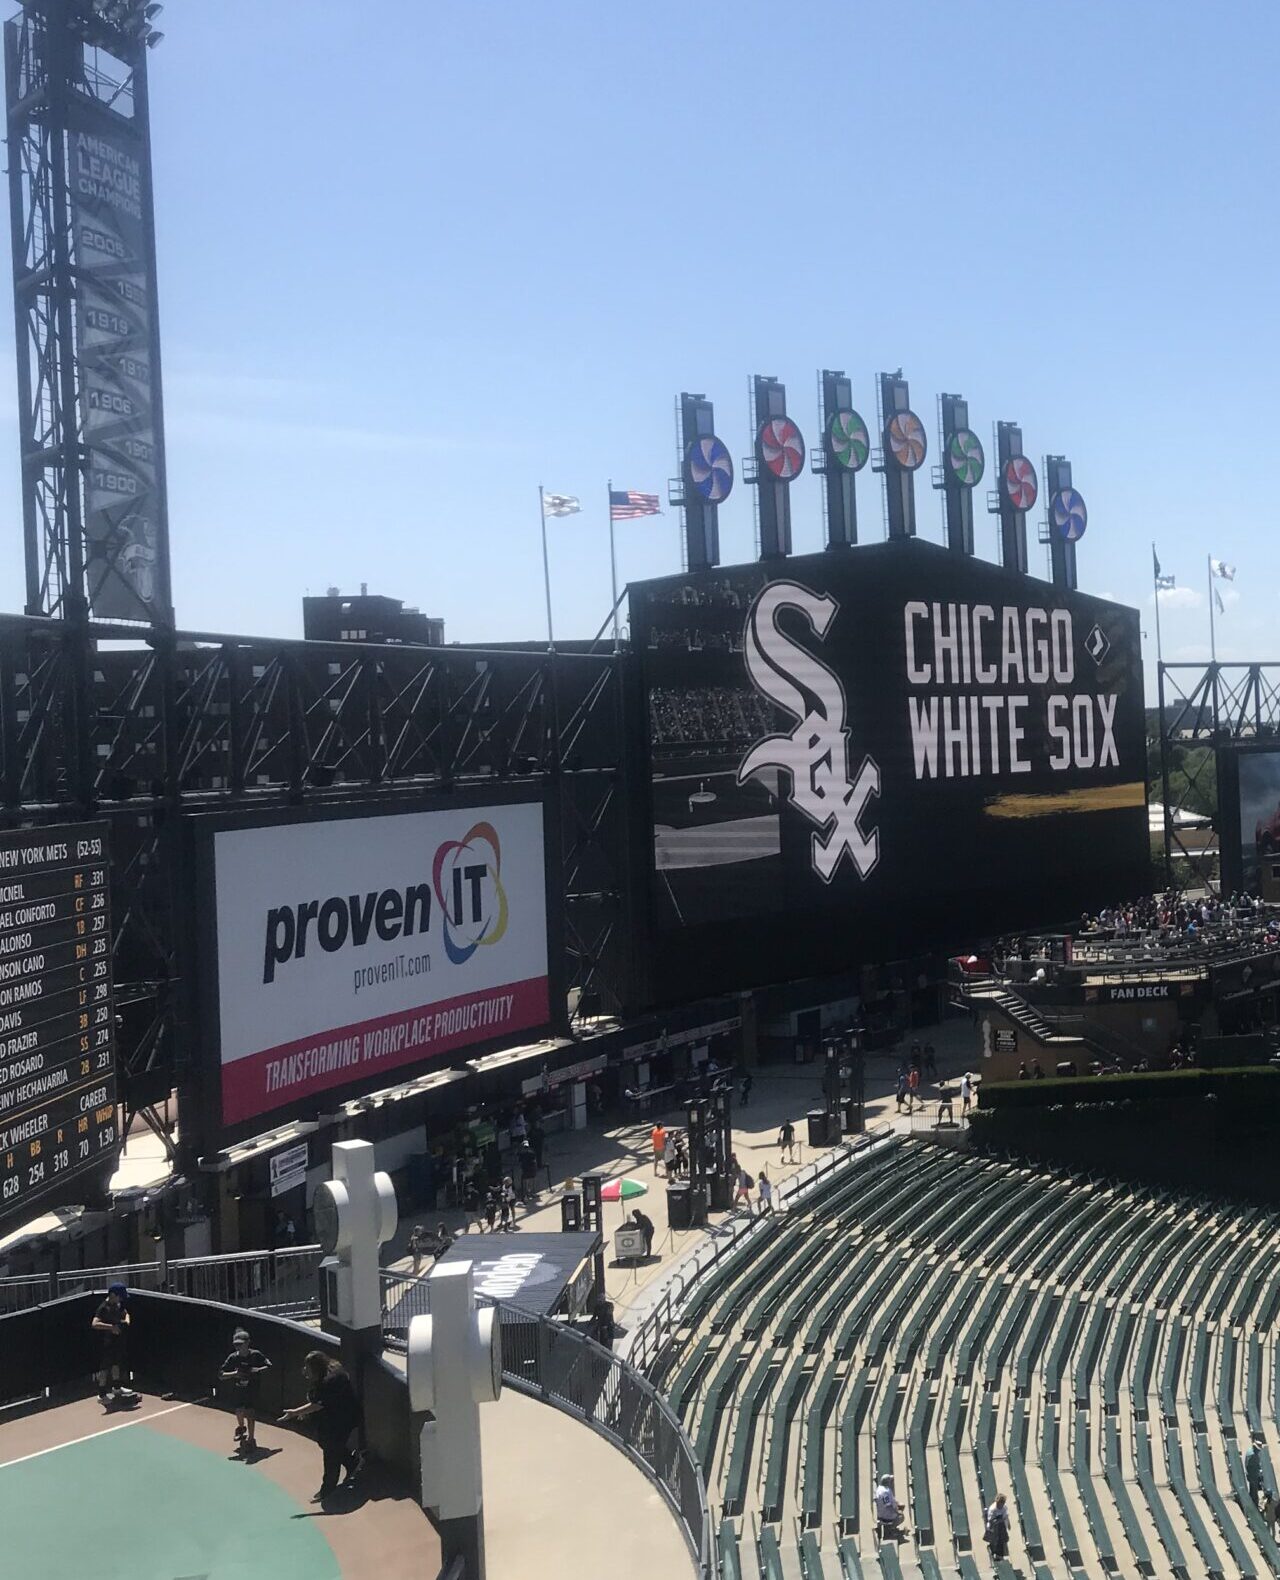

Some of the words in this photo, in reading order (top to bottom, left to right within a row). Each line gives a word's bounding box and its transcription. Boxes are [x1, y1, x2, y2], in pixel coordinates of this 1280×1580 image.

[77, 132, 140, 177] AMERICAN
[77, 151, 142, 201] LEAGUE
[81, 230, 125, 257] 2005
[87, 310, 128, 335] 1919
[90, 391, 132, 414] 1906
[95, 473, 136, 494] 1900
[904, 601, 1075, 684] CHICAGO
[908, 694, 1032, 780] WHITE
[1047, 693, 1120, 770] SOX
[21, 847, 45, 865] YORK
[46, 843, 68, 861] METS
[77, 838, 102, 859] (52-55)
[90, 871, 104, 886] .331
[15, 903, 56, 925] CONFORTO
[75, 897, 85, 912] CF
[76, 920, 86, 935] 1B
[92, 916, 105, 932] .257
[263, 883, 431, 985] proven
[22, 954, 45, 975] CANO
[76, 944, 87, 959] DH
[92, 938, 106, 955] .235
[354, 953, 431, 994] provenIT.com
[14, 979, 43, 1002] RAMOS
[79, 967, 85, 981] C
[93, 961, 107, 977] .255
[79, 989, 87, 1005] LF
[1110, 988, 1135, 999] FAN
[1137, 986, 1169, 998] DECK
[7, 1031, 38, 1056] FRAZIER
[79, 1013, 89, 1029] 3B
[94, 1006, 108, 1024] .250
[266, 1037, 360, 1094] TRANSFORMING
[363, 1016, 432, 1061] WORKPLACE
[434, 995, 514, 1040] PRODUCTIVITY
[10, 1053, 44, 1080] ROSARIO
[80, 1036, 89, 1052] SS
[95, 1028, 109, 1046] .274
[16, 1069, 68, 1103] HECHAVARRIA
[80, 1059, 90, 1075] 2B
[96, 1051, 110, 1069] .231
[79, 1086, 107, 1112] CAREER
[6, 1152, 14, 1169] H
[30, 1140, 41, 1158] BB
[57, 1129, 64, 1144] R
[78, 1117, 89, 1134] HR
[95, 1104, 113, 1125] WHIP
[10, 1113, 48, 1146] WHEELER
[3, 1175, 19, 1199] 628
[28, 1162, 45, 1186] 254
[53, 1149, 69, 1172] 318
[79, 1139, 89, 1159] 70
[98, 1126, 114, 1148] 1.30
